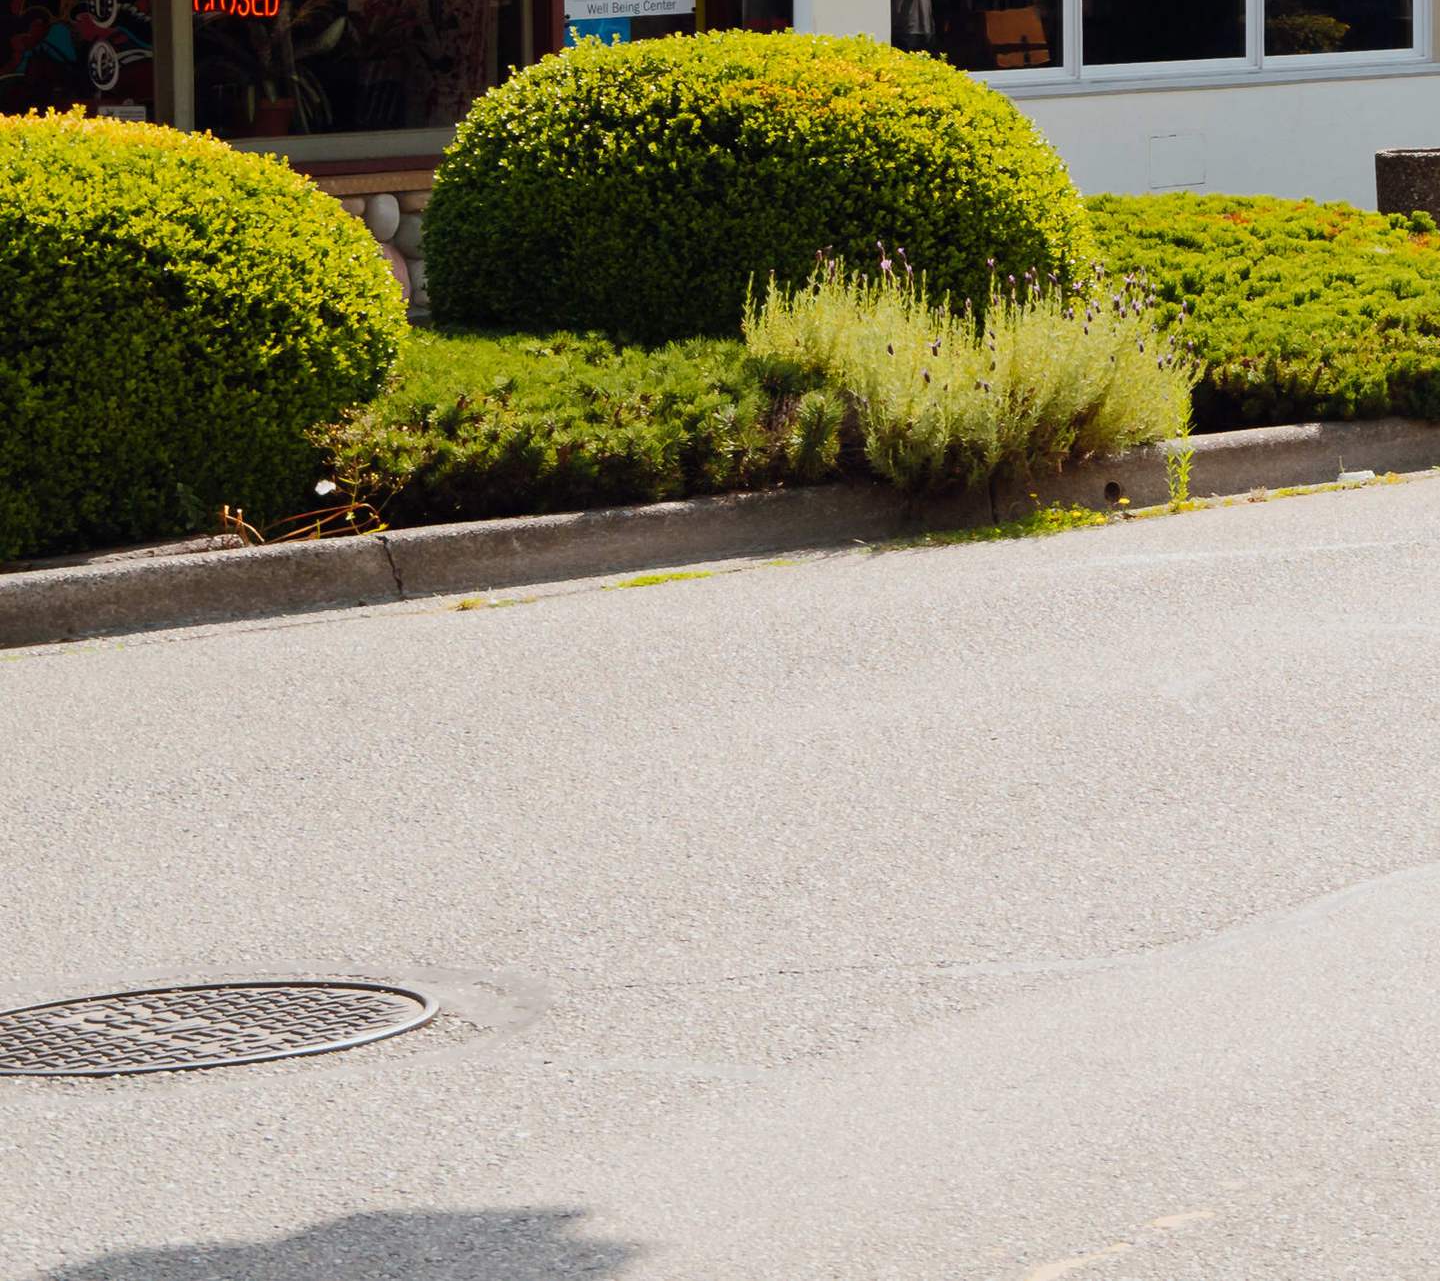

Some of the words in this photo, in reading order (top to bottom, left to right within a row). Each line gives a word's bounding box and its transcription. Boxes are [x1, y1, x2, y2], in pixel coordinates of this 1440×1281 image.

[587, 3, 608, 15] Well
[612, 1, 640, 15] Being
[643, 0, 676, 12] Center
